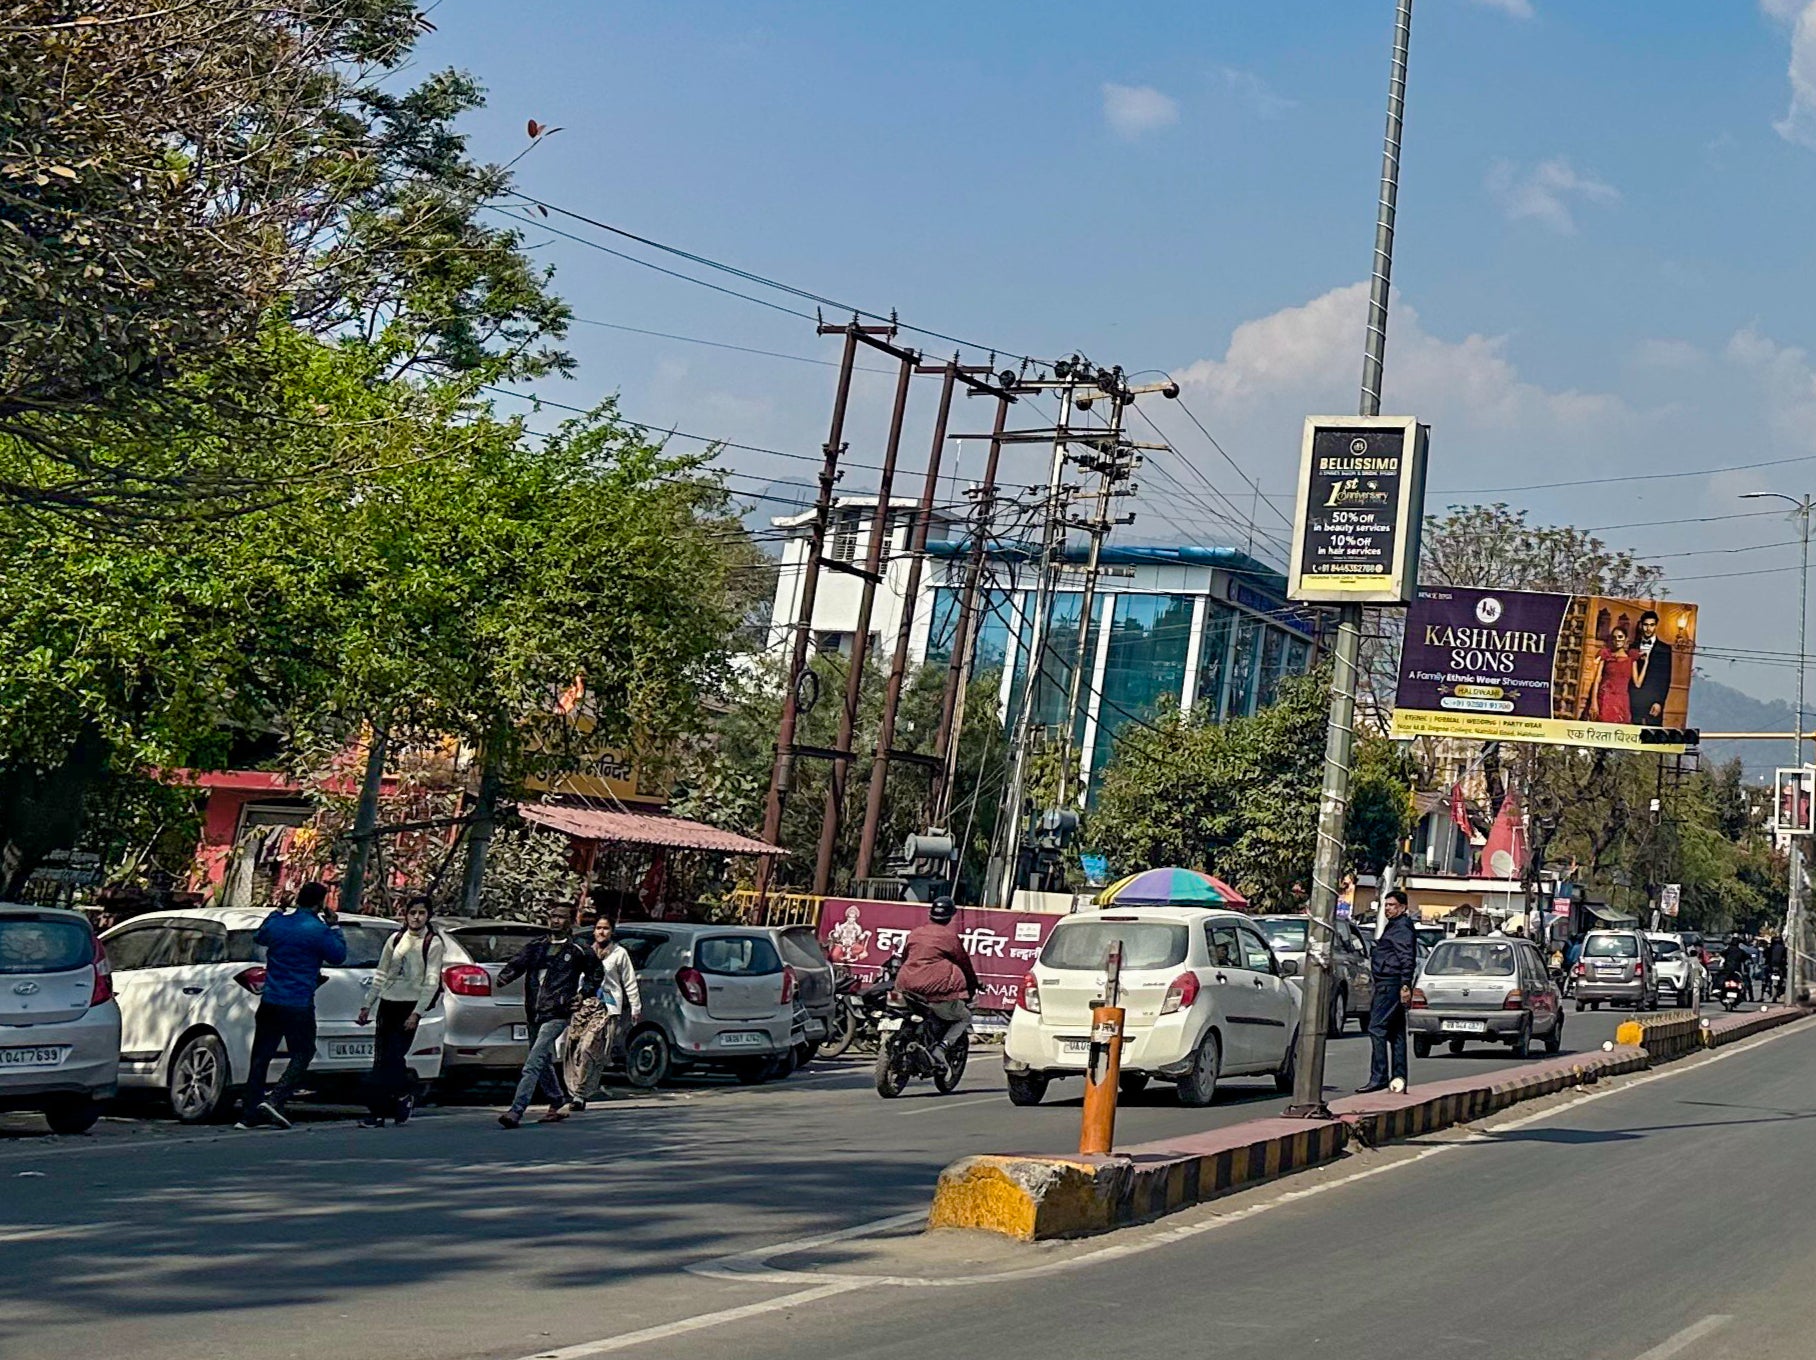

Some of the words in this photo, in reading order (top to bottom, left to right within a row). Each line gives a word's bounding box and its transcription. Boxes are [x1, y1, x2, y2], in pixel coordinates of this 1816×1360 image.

[1319, 458, 1398, 470] BELLISSIMO
[1324, 523, 1354, 533] beauty
[1356, 523, 1391, 532] services
[1328, 546, 1346, 555] hair
[1347, 547, 1382, 555] services
[1424, 625, 1548, 654] KASHMIRI
[1450, 649, 1515, 673] SONS
[1417, 672, 1446, 683] Family
[1447, 674, 1475, 683] Ethnic
[1476, 675, 1500, 685] Wear
[1502, 676, 1550, 689] Showroom
[1566, 728, 1584, 740] एक
[1586, 727, 1611, 741] रिश्ता
